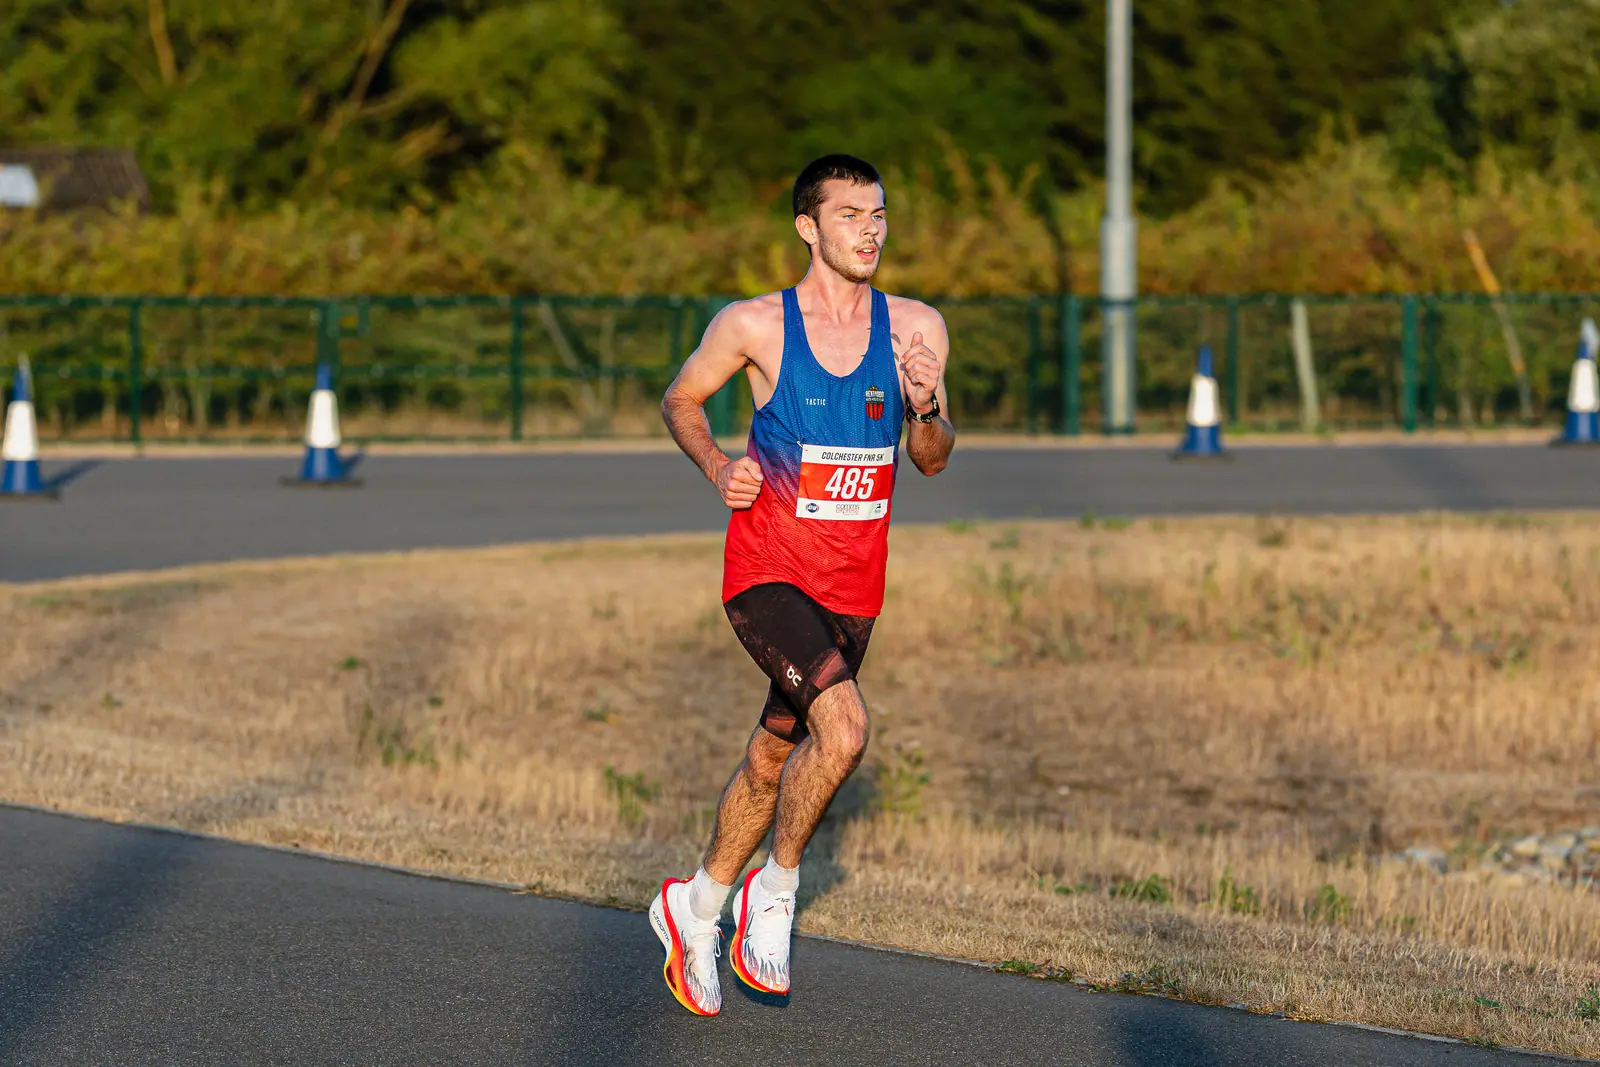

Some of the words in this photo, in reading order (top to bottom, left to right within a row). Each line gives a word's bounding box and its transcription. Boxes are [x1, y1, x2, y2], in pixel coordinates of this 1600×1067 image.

[805, 398, 826, 406] TACTIC
[821, 451, 863, 462] COLCHESTER
[863, 454, 877, 462] FNR
[876, 453, 885, 462] 5K
[824, 467, 878, 500] 485
